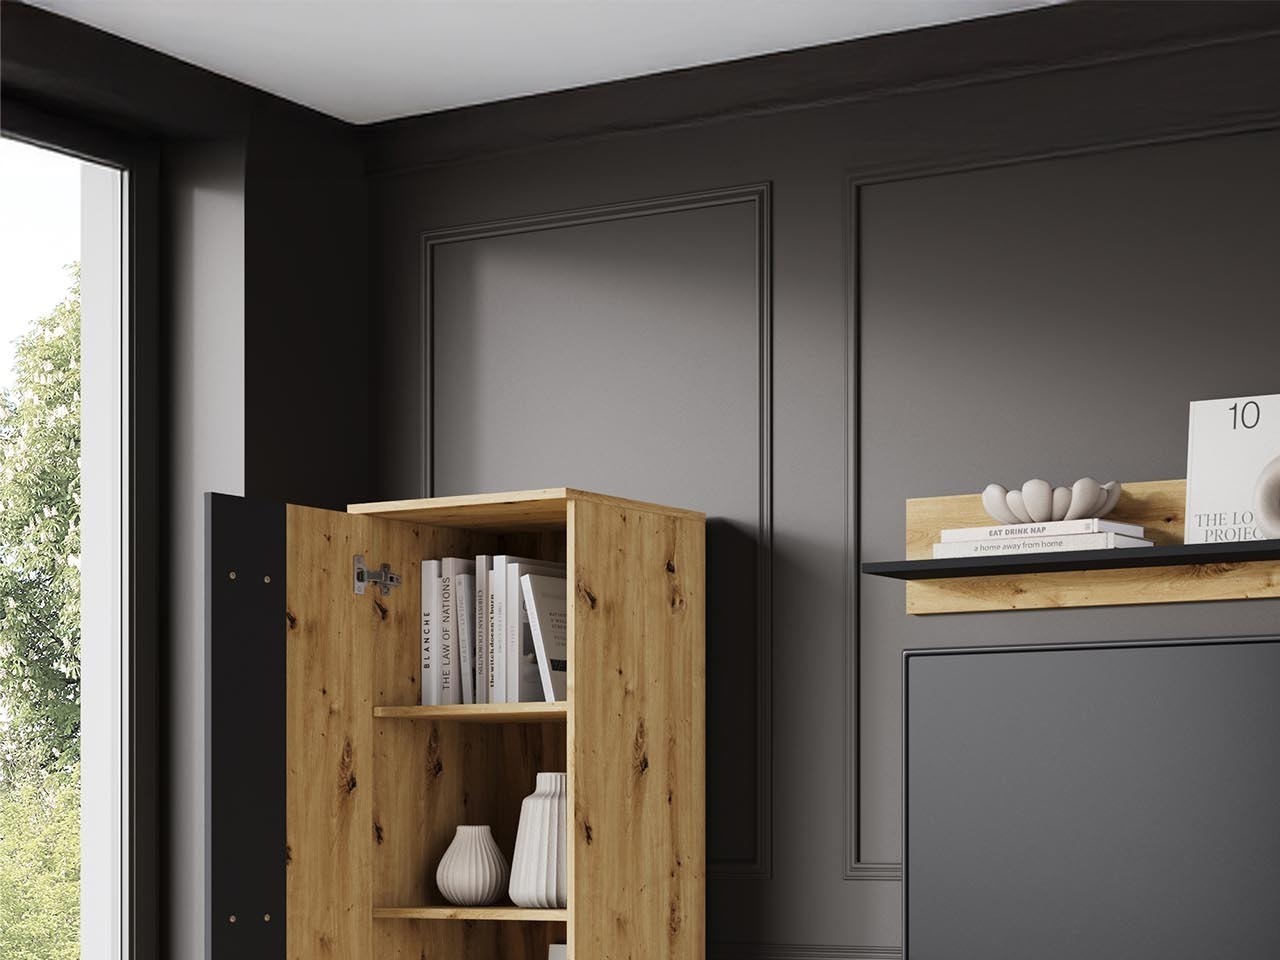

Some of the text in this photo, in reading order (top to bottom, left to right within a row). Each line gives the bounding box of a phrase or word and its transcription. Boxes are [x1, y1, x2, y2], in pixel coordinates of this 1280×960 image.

[1228, 401, 1260, 430] 10
[1195, 513, 1227, 527] THE
[989, 527, 1046, 537] EAT DRINK NAP
[980, 543, 1001, 551] home
[1002, 543, 1020, 552] away
[1022, 541, 1039, 549] from
[1041, 540, 1063, 548] home
[423, 612, 431, 669] BLANCHE
[442, 577, 450, 690] THE LAW OF NATIONS
